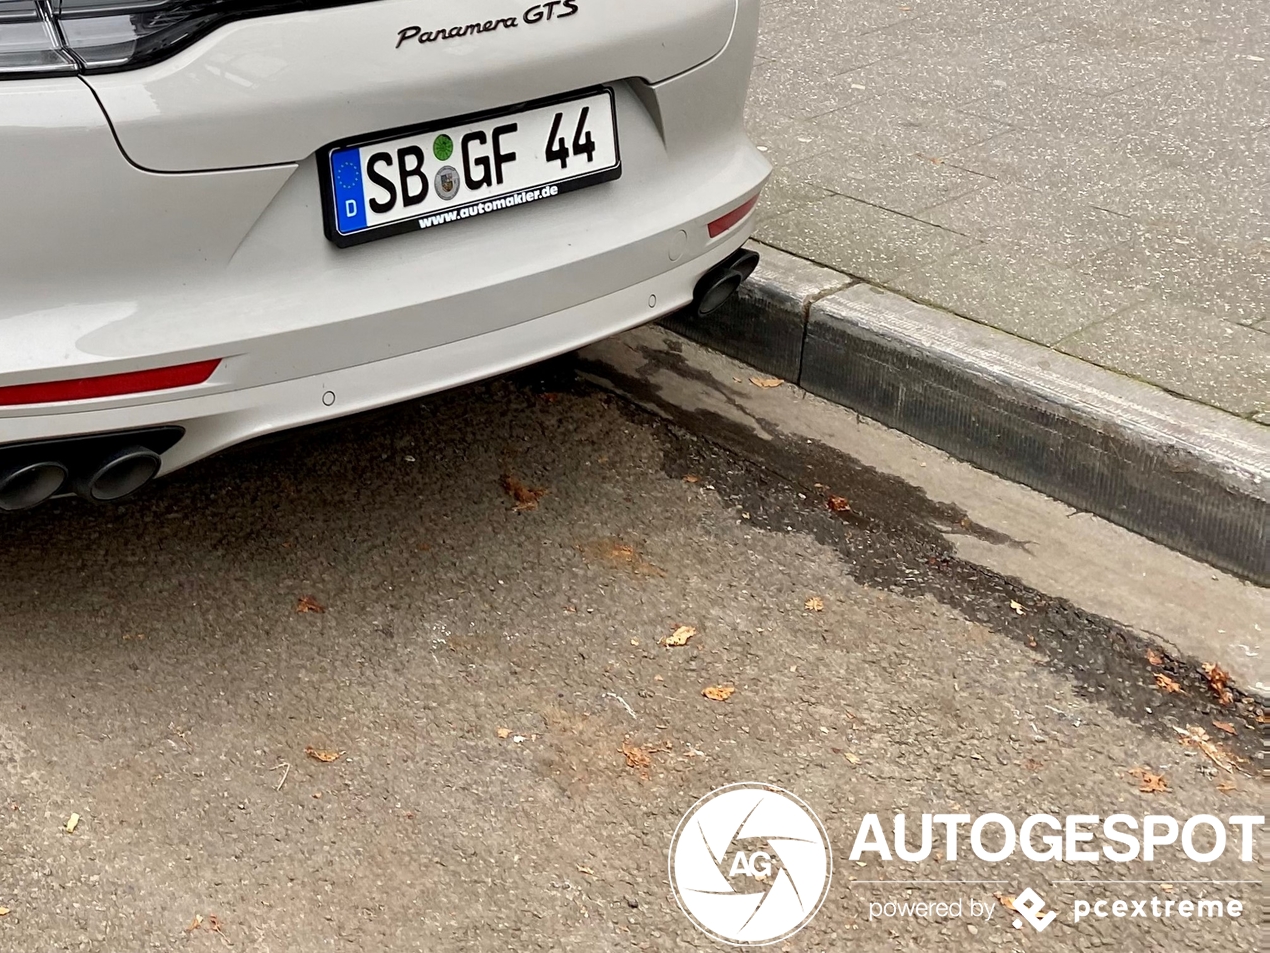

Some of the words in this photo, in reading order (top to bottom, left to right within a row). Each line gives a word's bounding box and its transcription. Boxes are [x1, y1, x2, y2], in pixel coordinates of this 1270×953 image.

[394, 16, 519, 50] Panamera
[366, 144, 429, 215] SB
[460, 122, 519, 191] GF
[544, 106, 596, 170] 44
[344, 199, 357, 218] D
[418, 184, 559, 229] www.automakler.de
